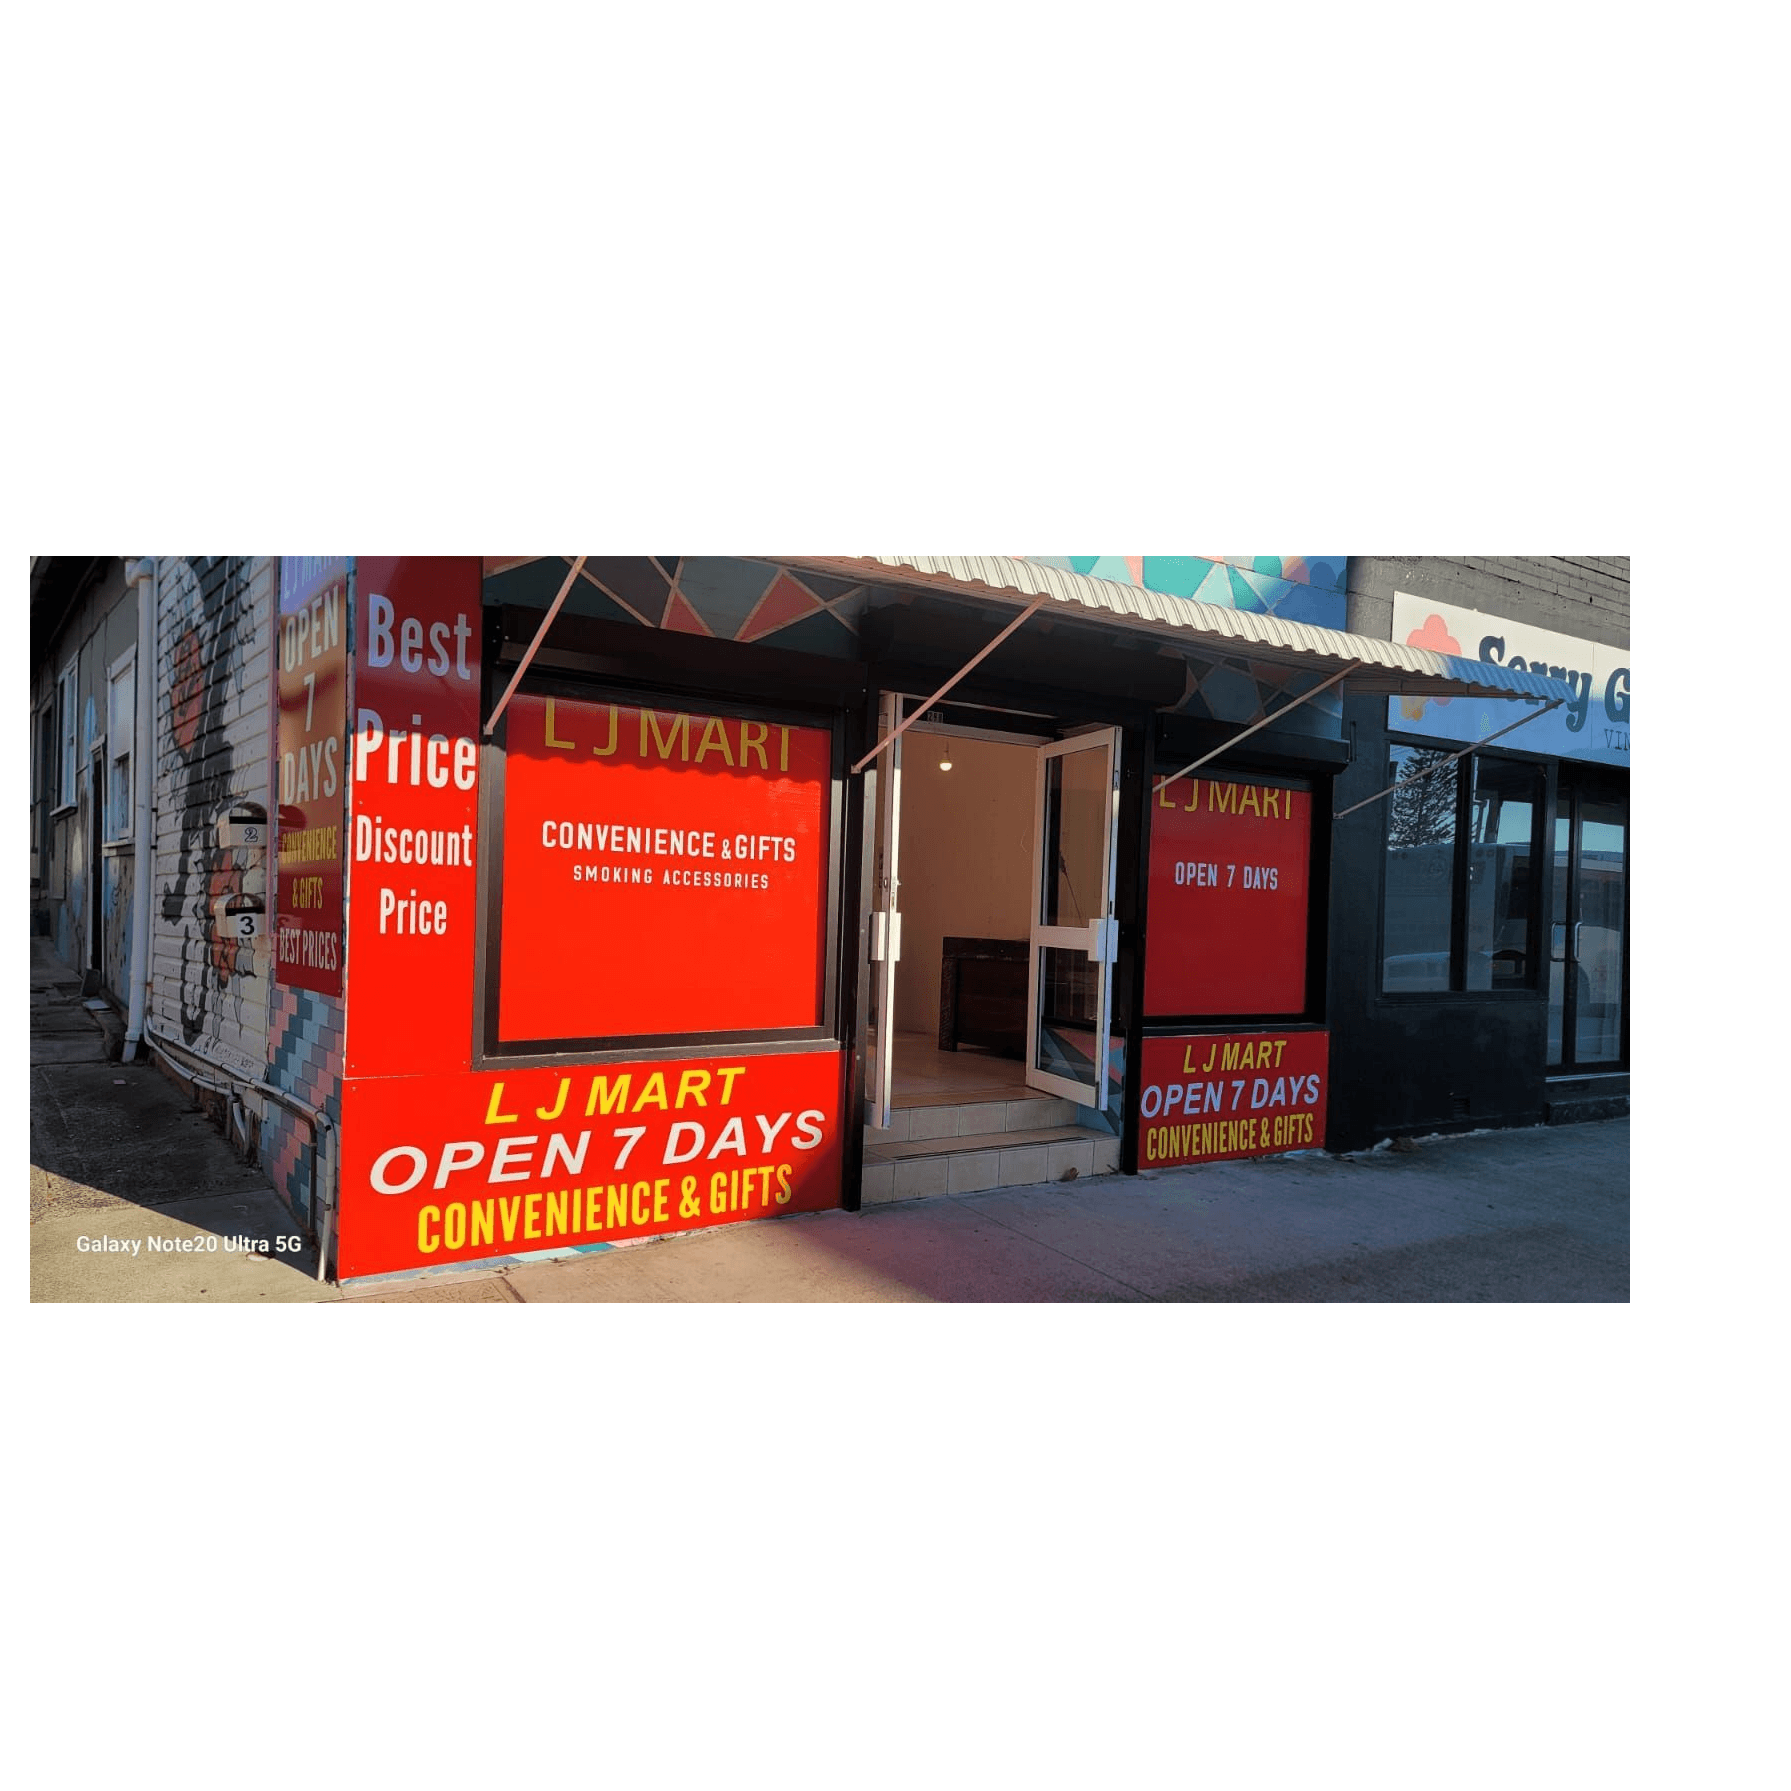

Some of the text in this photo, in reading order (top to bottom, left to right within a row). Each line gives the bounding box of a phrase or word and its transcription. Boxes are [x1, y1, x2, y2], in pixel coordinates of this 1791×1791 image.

[285, 585, 338, 673] OPEN
[368, 593, 472, 680] Best
[304, 672, 316, 732] 7
[356, 708, 477, 790] Price
[545, 697, 799, 772] L J MART
[284, 736, 338, 806] DAYS
[1159, 775, 1176, 809] L
[1184, 779, 1199, 812] J
[244, 826, 259, 843] 2
[281, 825, 338, 866] CONVENIENCE
[356, 814, 472, 867] Discount
[542, 820, 716, 858] CONVENIENCE
[573, 865, 770, 889] SMOKING ACCESSORIES
[1174, 861, 1279, 890] OPEN 7 DAYS
[240, 915, 255, 936] 3
[379, 887, 448, 935] Price
[279, 926, 337, 972] BEST PRICES
[1183, 1040, 1288, 1074] L J MART
[484, 1067, 746, 1125] L J MART
[1140, 1073, 1321, 1118] OPEN 7 DAYS
[369, 1109, 826, 1196] OPEN 7 DAYS
[1146, 1112, 1314, 1161] CONVENIENCE & GIFTS
[417, 1163, 792, 1254] CONVENIENCE & GIFTS
